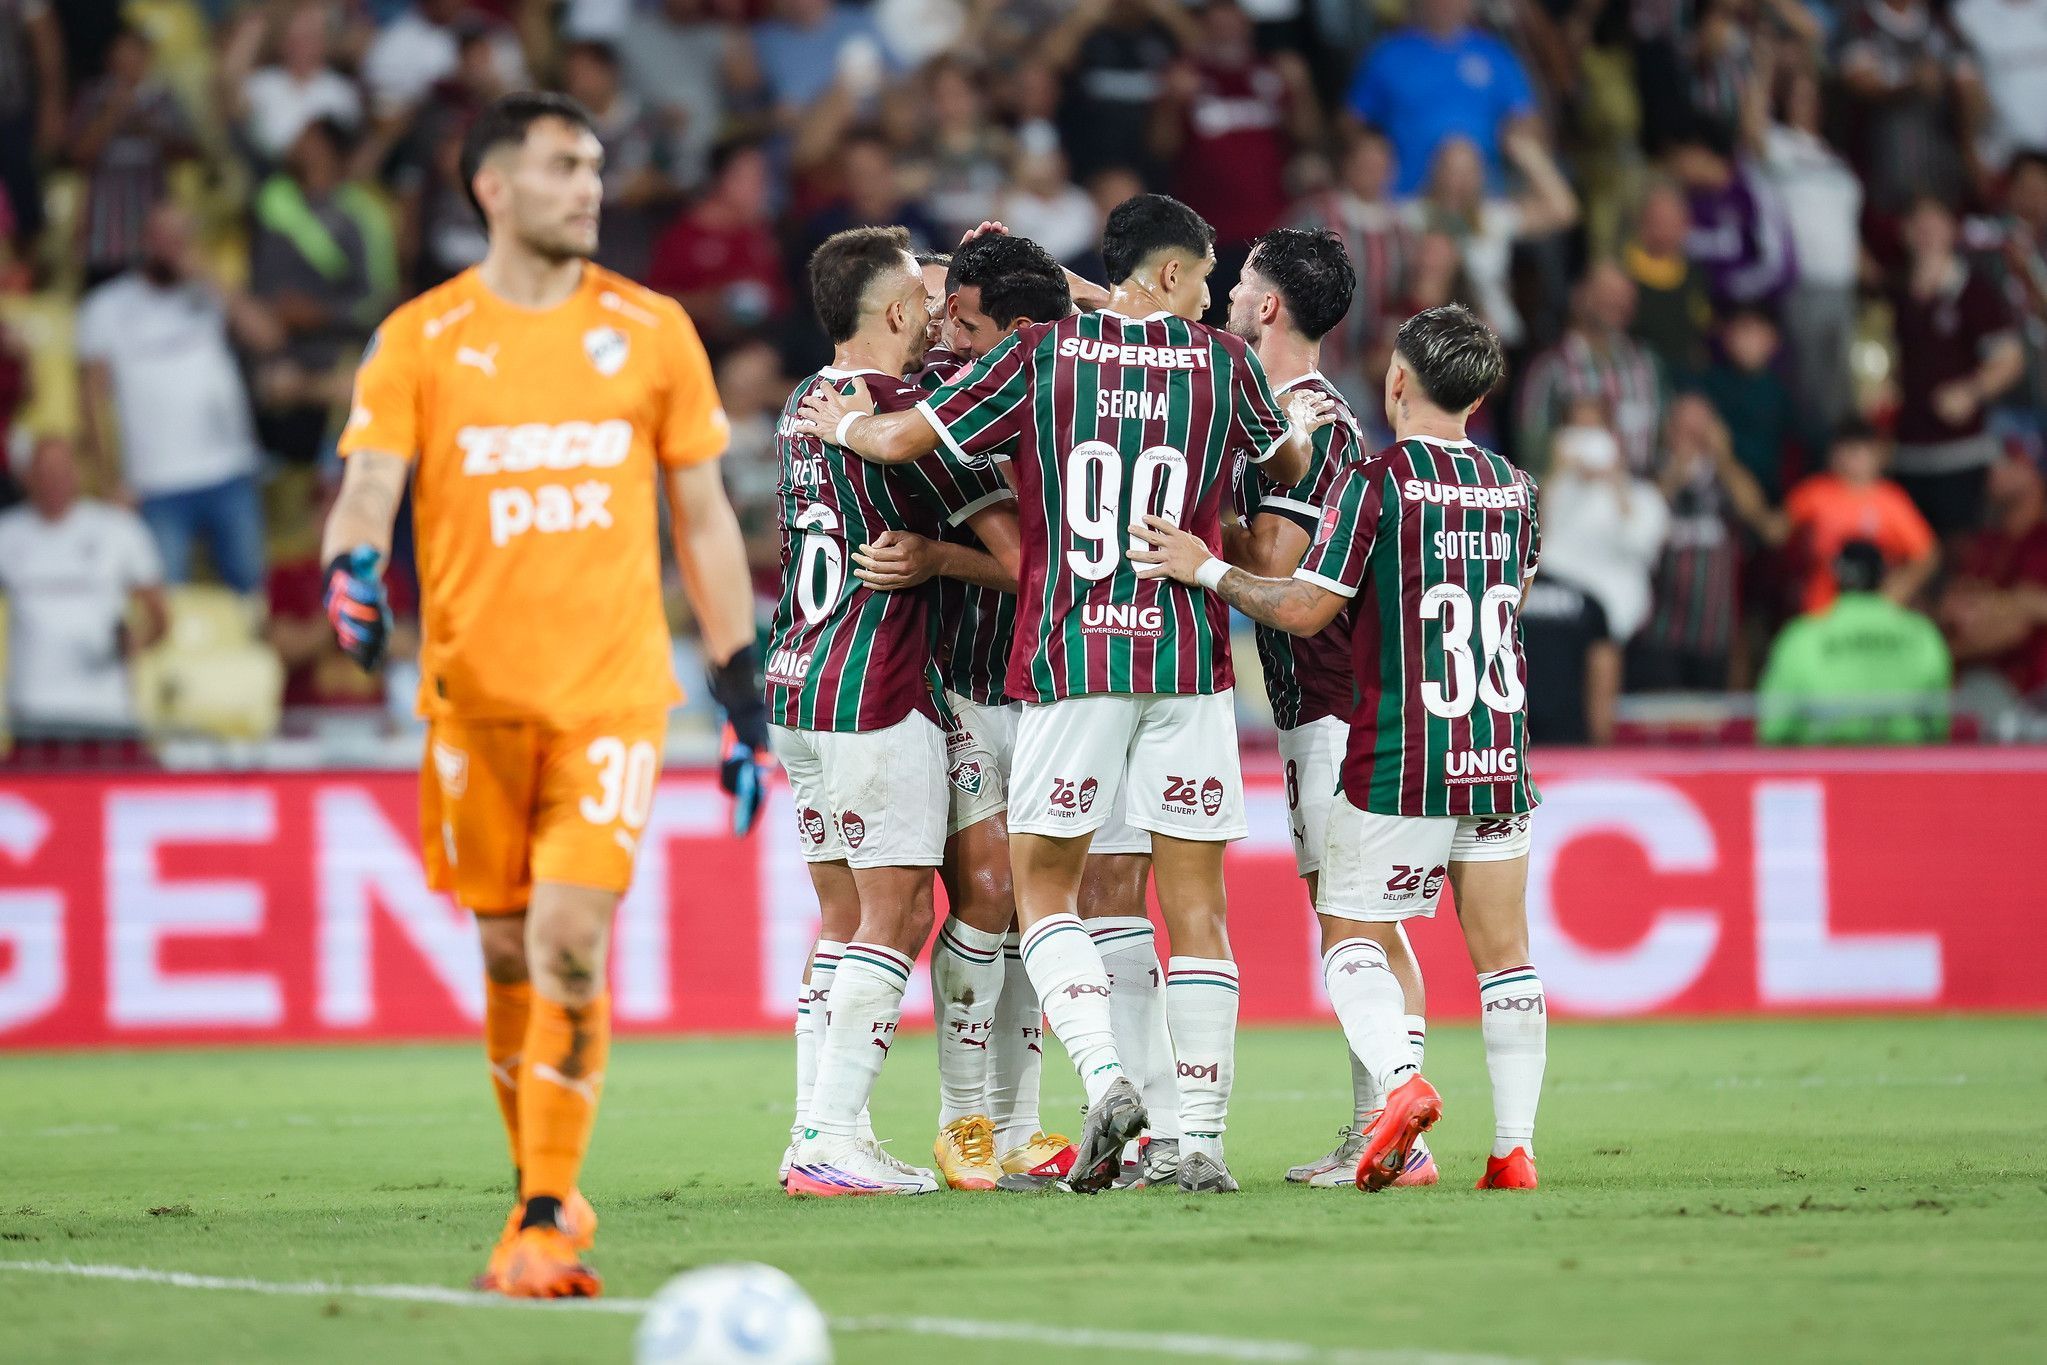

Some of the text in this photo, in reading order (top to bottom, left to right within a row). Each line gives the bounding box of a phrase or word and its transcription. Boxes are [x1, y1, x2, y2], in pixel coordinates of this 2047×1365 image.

[1059, 337, 1208, 369] SUPERBET
[1096, 389, 1168, 421] SERNA
[1404, 479, 1526, 508] SUPERBET
[489, 479, 614, 548] pax
[1066, 440, 1189, 581] 90
[1433, 530, 1512, 561] SOTELDO
[1081, 604, 1163, 629] UNIG
[1081, 627, 1162, 638] UNIVERSIDADE IGUAÇU
[945, 731, 974, 747] EGA
[1446, 747, 1518, 776] UNIG
[580, 736, 656, 829] 30
[1050, 777, 1077, 809] Zé
[1162, 775, 1198, 806] Zé
[1445, 774, 1518, 785] UNIVERSIDADE IGUAÇU
[1161, 804, 1198, 816] DELIVERY
[1386, 865, 1424, 891] Zé
[1383, 892, 1416, 901] DELIVERY
[1062, 983, 1112, 999] 100
[1486, 994, 1544, 1014] 1001
